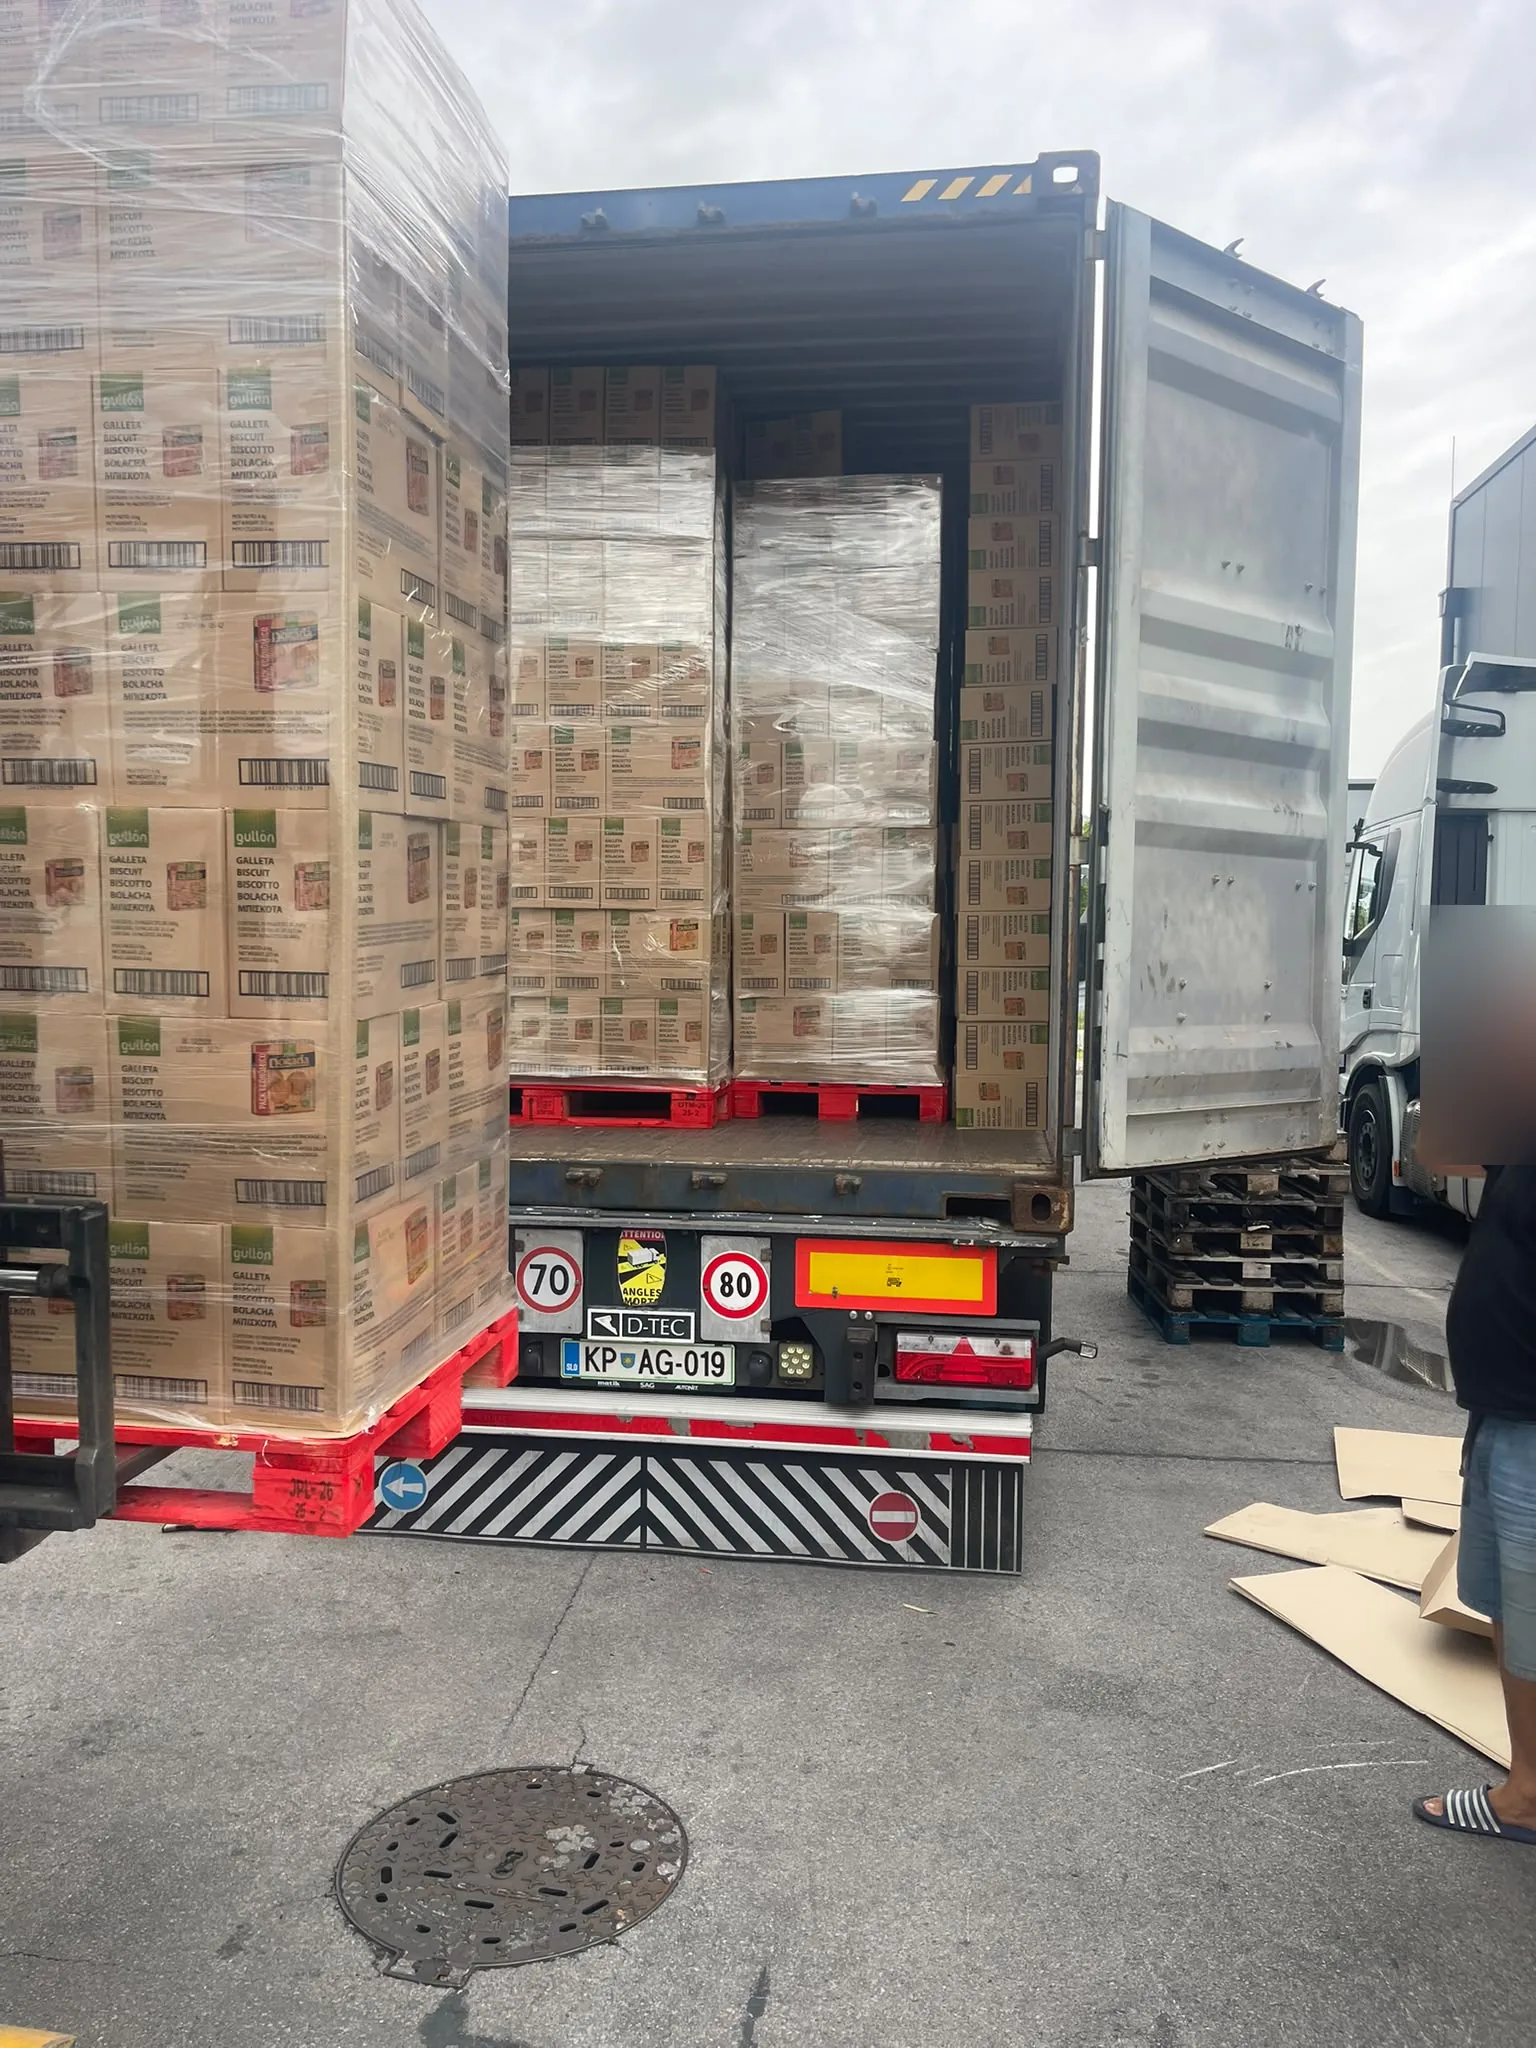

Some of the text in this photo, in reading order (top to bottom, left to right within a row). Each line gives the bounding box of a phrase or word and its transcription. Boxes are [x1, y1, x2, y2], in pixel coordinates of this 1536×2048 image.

[104, 422, 141, 430] GALLETA
[230, 421, 269, 429] GALLETA
[104, 434, 137, 442] BISCUIT
[104, 446, 147, 455] BISCOTTO
[230, 446, 274, 454] BISCOTTO
[104, 458, 146, 467] BOLACHA
[231, 458, 274, 467] BOLACHA
[109, 831, 147, 846] gullón
[236, 832, 274, 846] gullón
[110, 856, 147, 864] GALLETA
[236, 856, 274, 865] GALLETA
[110, 868, 142, 876] BISCUIT
[237, 869, 270, 877] BISCUIT
[110, 880, 152, 888] BISCOTTO
[237, 880, 279, 889] BISCOTTO
[110, 891, 151, 899] BOLACHA
[237, 892, 279, 901] BOLACHA
[121, 1040, 160, 1055] gullón
[122, 1065, 158, 1073] GALLETA
[122, 1089, 163, 1097] BISCOTTO
[123, 1100, 162, 1108] BOLACHA
[109, 1242, 147, 1258] gullón
[233, 1248, 272, 1262] gullón
[233, 1272, 270, 1280] GALLETA
[530, 1264, 569, 1295] 70
[233, 1284, 265, 1292] BISCUIT
[720, 1272, 752, 1297] 80
[623, 1288, 662, 1297] ANGLES
[233, 1307, 273, 1315] BOLACHA
[628, 1317, 684, 1336] D-TEC
[585, 1346, 725, 1377] KP AG-019
[566, 1363, 578, 1371] SLO
